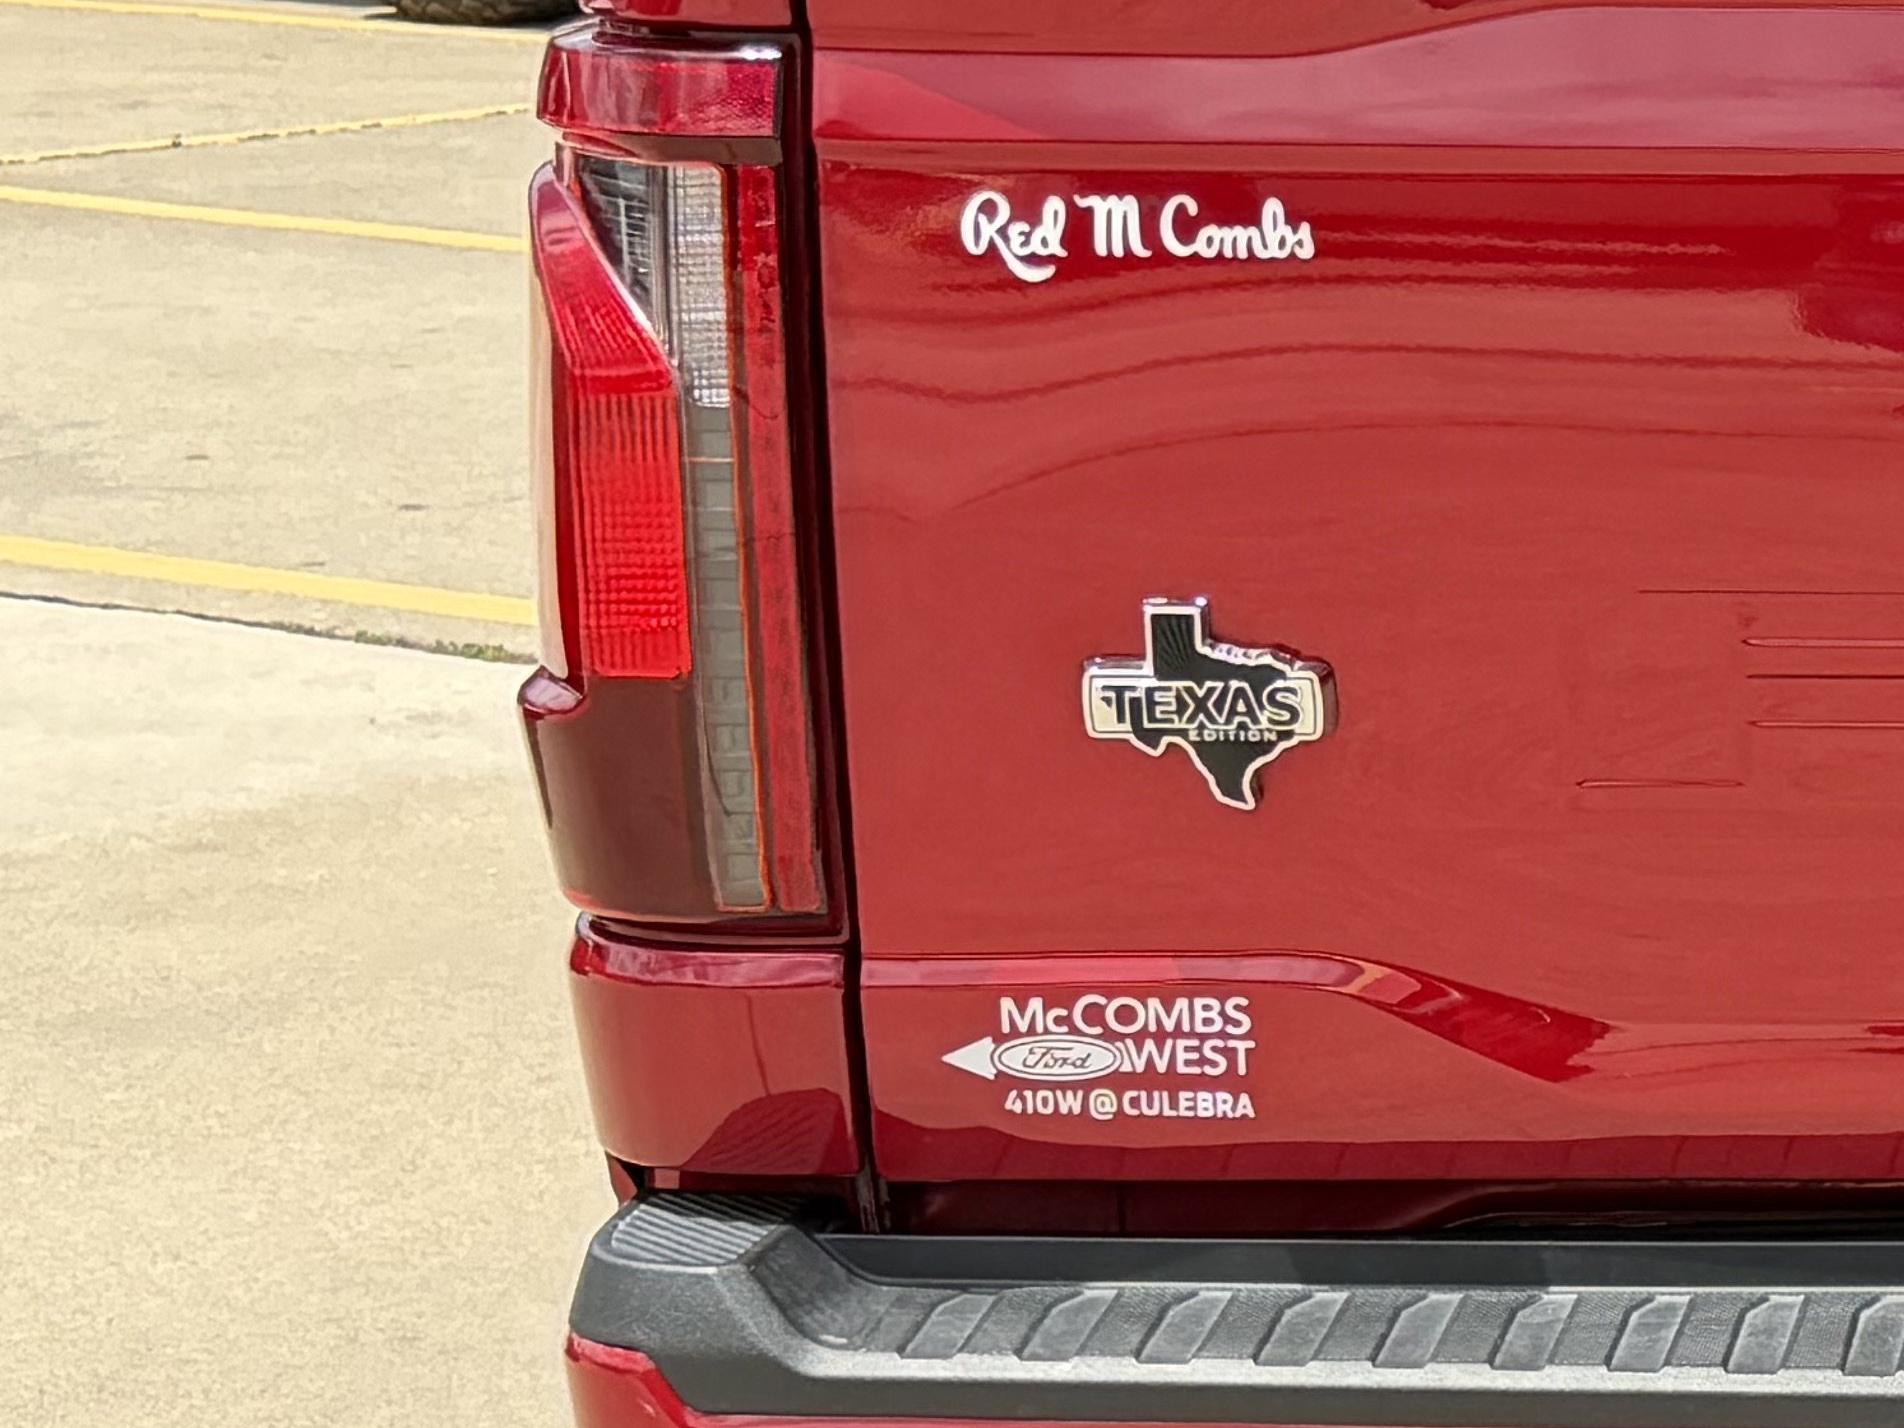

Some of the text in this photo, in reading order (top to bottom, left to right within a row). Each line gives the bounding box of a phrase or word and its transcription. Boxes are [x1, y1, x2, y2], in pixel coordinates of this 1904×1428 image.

[959, 190, 1069, 283] Red
[1100, 680, 1303, 729] TEXAS
[1189, 729, 1278, 742] EDITION
[1000, 995, 1252, 1035] McCOMBS
[1022, 1039, 1256, 1076] Ford WEST
[1005, 1089, 1255, 1120] 410W @ CULEBRA
